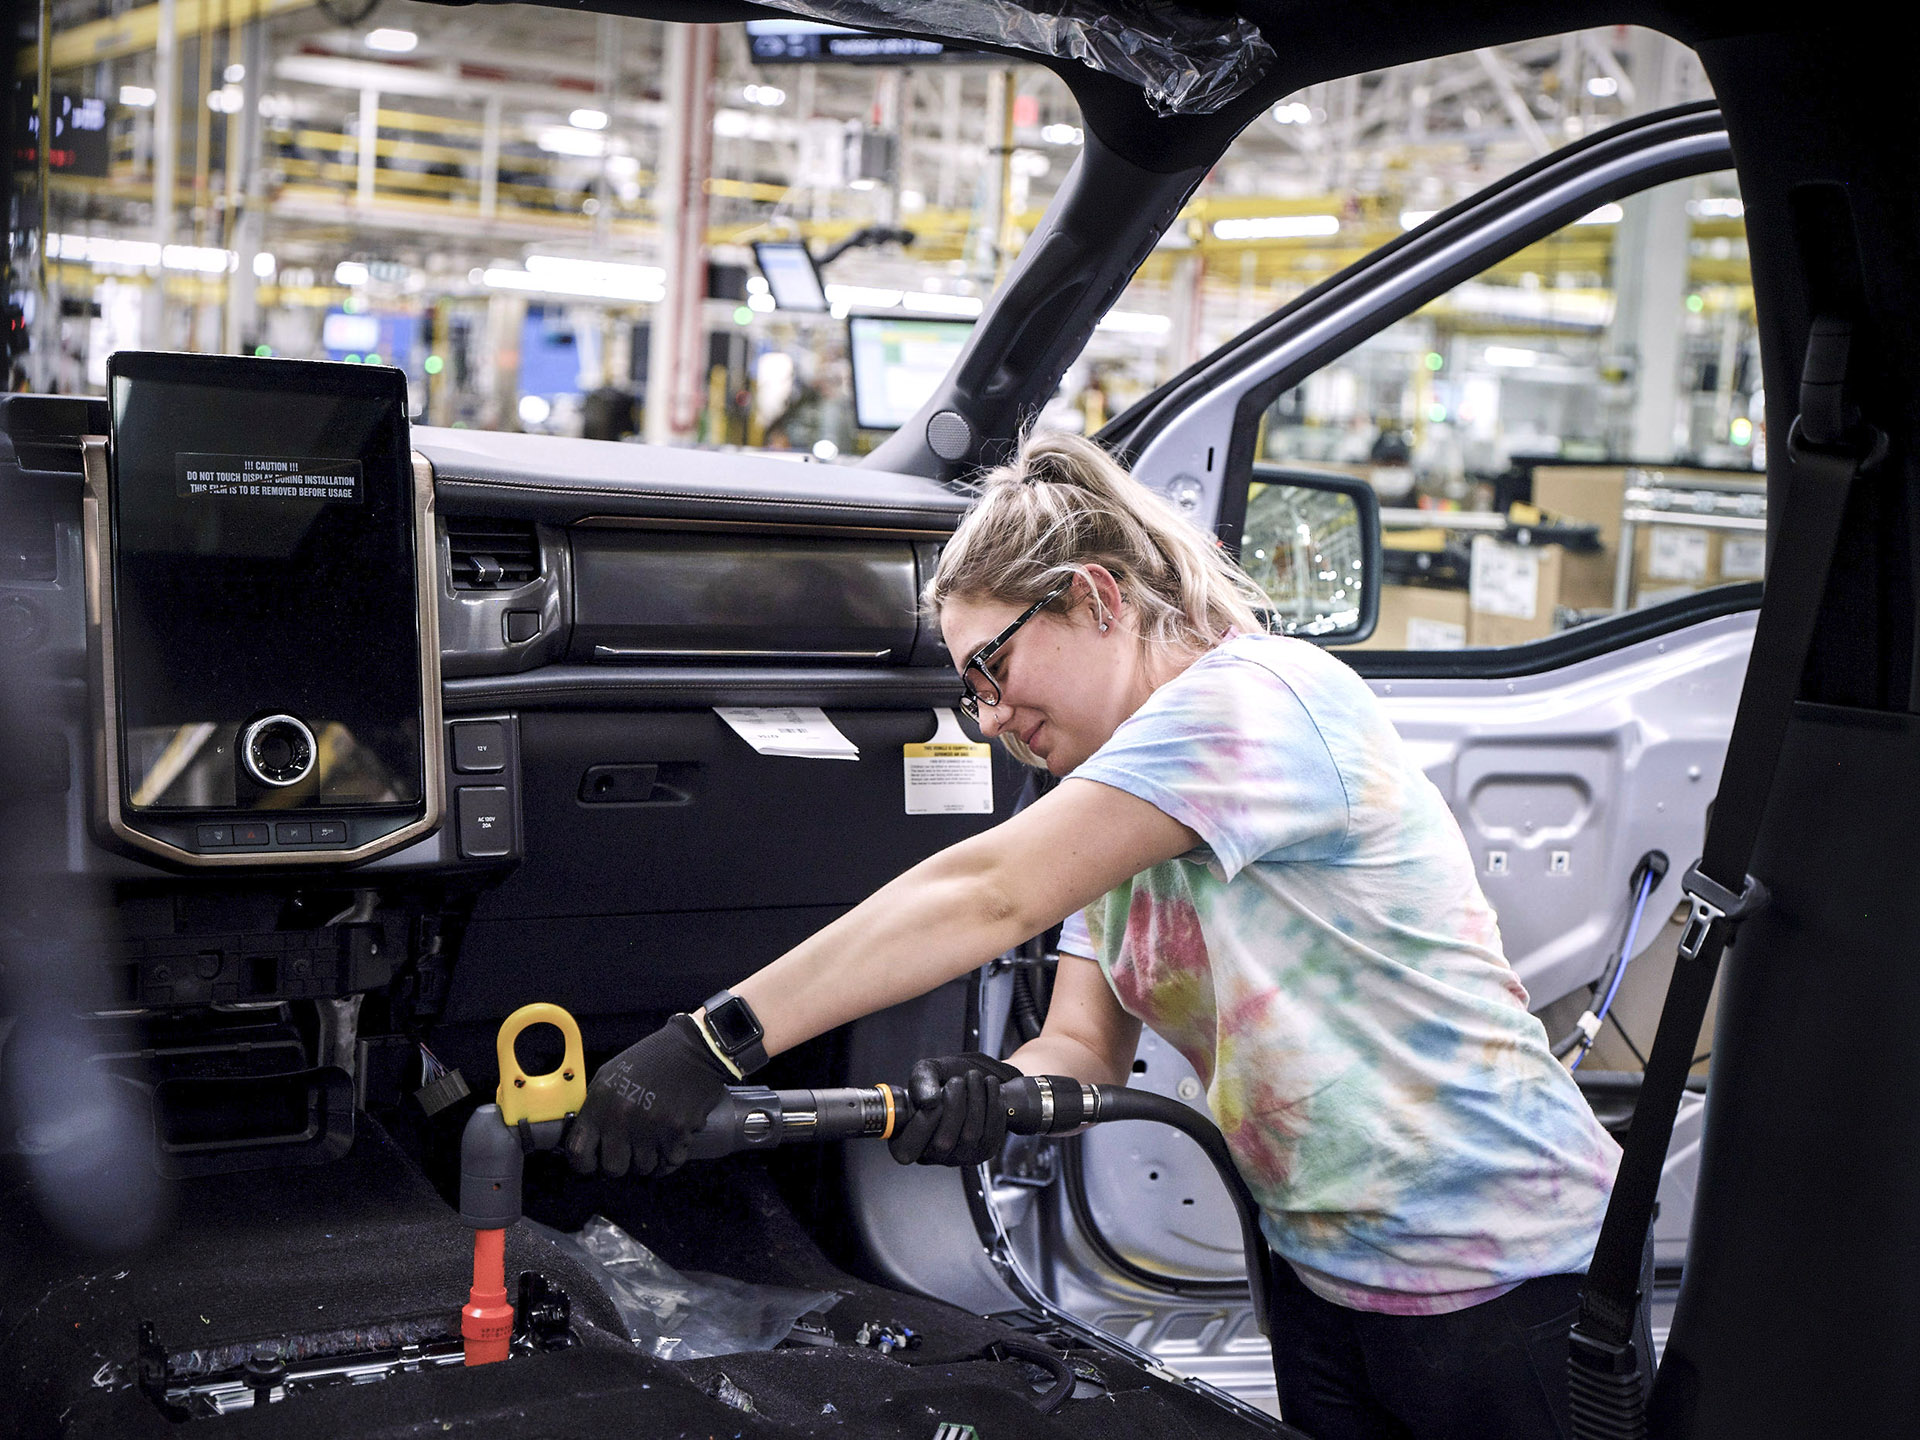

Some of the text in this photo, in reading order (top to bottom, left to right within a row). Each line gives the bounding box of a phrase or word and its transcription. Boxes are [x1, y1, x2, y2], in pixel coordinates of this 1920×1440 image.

[244, 461, 299, 472] !!! CAUTION !!!
[186, 471, 355, 486] DO NOT TOUCH DISPLAY DURING INSTALLATION
[190, 483, 207, 493] THIS
[229, 485, 237, 494] IS
[239, 485, 249, 495] TO
[250, 486, 260, 495] BE
[261, 486, 297, 496] REMOVED
[298, 487, 327, 497] BEFORE
[328, 488, 353, 498] USAGE
